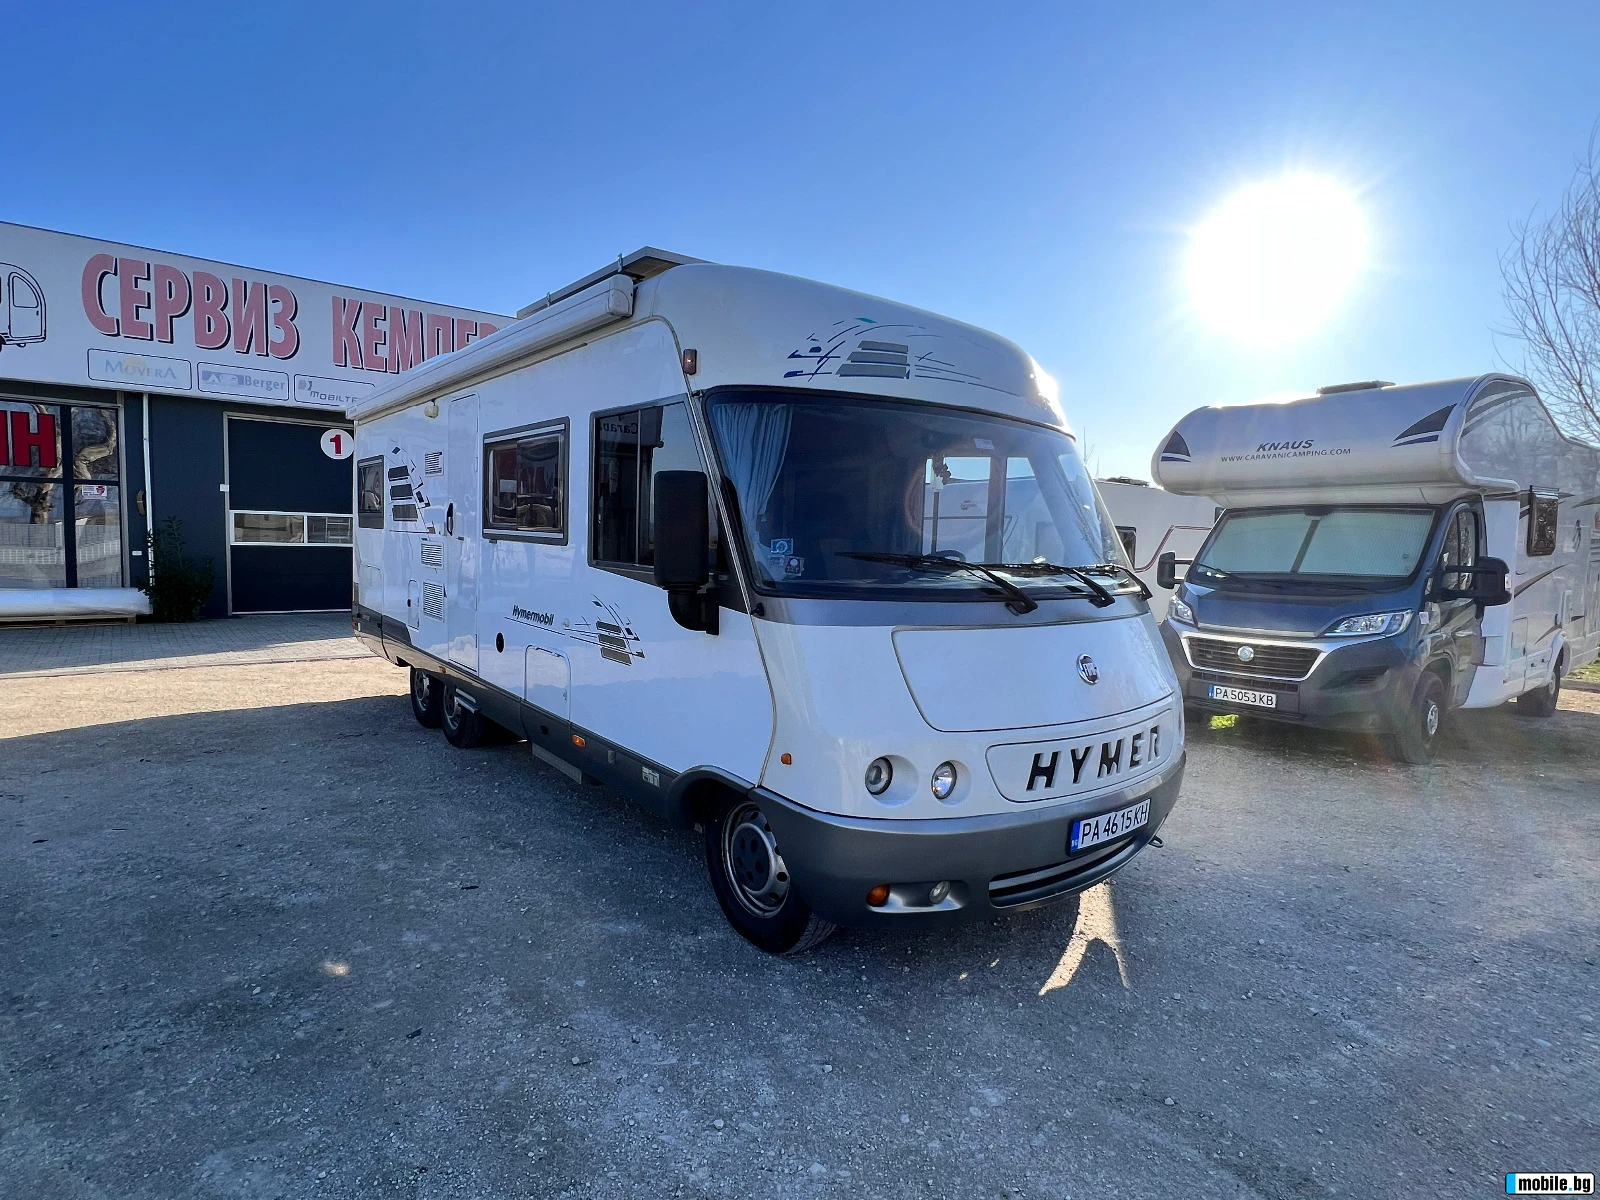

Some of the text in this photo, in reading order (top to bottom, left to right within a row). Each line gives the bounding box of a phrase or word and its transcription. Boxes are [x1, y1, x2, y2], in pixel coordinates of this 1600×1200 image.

[81, 253, 500, 374] СЕРВИЗ КЕМП
[244, 375, 286, 392] Berger
[329, 433, 342, 455] 1
[1256, 439, 1315, 453] KNAUS
[1220, 448, 1351, 463] WWW.CARAVANICAMPING.COM
[512, 604, 555, 627] Hymermobil
[1025, 725, 1160, 792] HYMER
